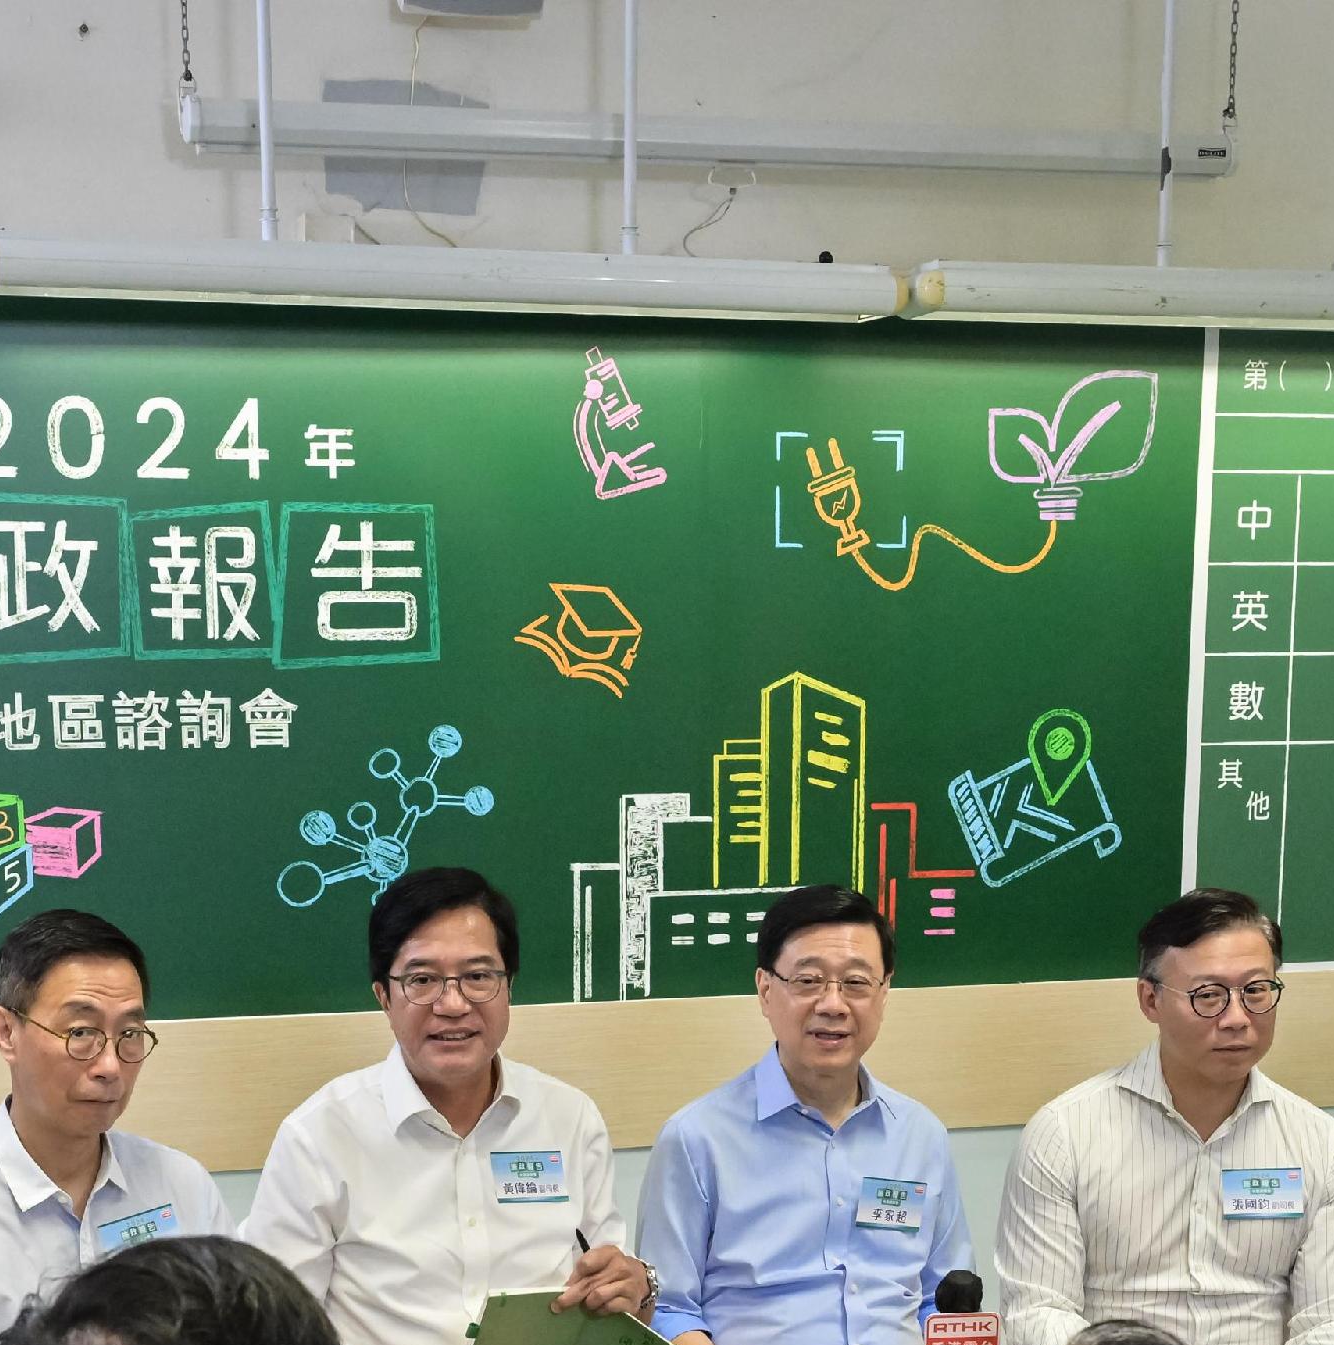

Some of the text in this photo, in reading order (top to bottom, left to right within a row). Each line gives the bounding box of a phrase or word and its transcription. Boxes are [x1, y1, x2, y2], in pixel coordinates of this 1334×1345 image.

[1237, 499, 1272, 540] 中
[1232, 590, 1269, 631] 英
[1229, 680, 1265, 720] 數
[4, 859, 21, 893] 5
[872, 1208, 907, 1223] 李家超
[933, 1321, 993, 1334] RTHK
